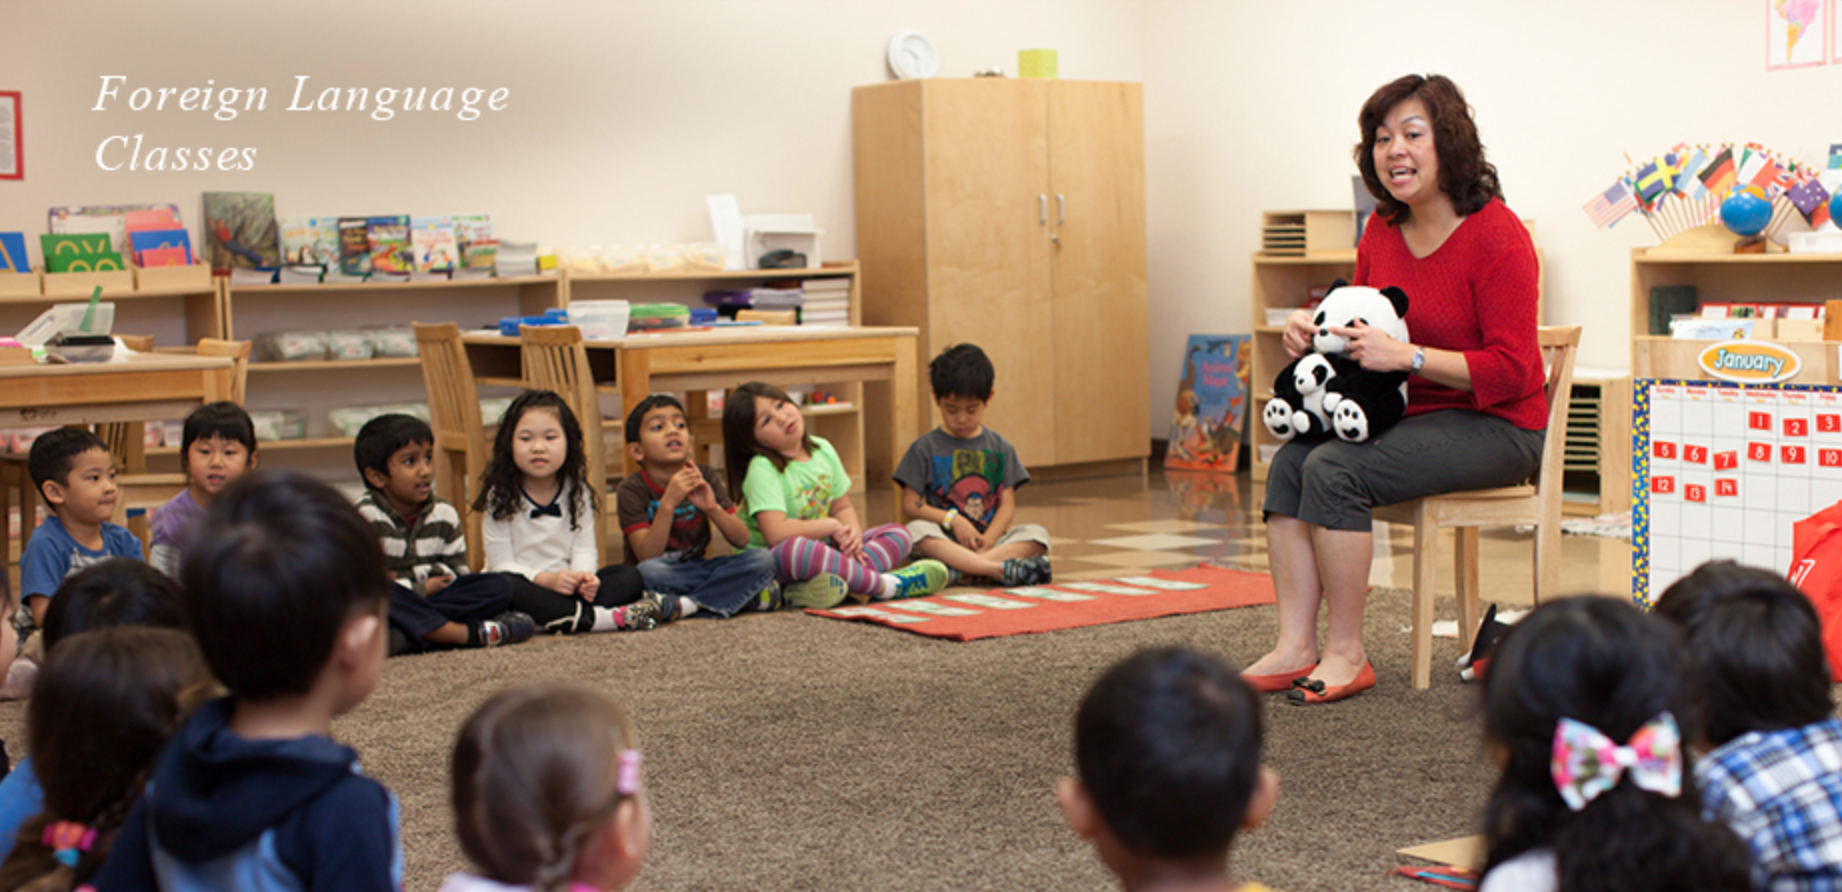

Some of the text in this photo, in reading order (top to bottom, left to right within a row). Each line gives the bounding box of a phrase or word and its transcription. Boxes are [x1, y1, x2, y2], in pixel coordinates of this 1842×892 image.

[1713, 348, 1785, 378] January
[1791, 422, 1800, 434] 2
[1825, 416, 1834, 430] 3
[1661, 445, 1838, 467] 5 6 7 8 9 10
[1657, 479, 1732, 499] 12 13 14
